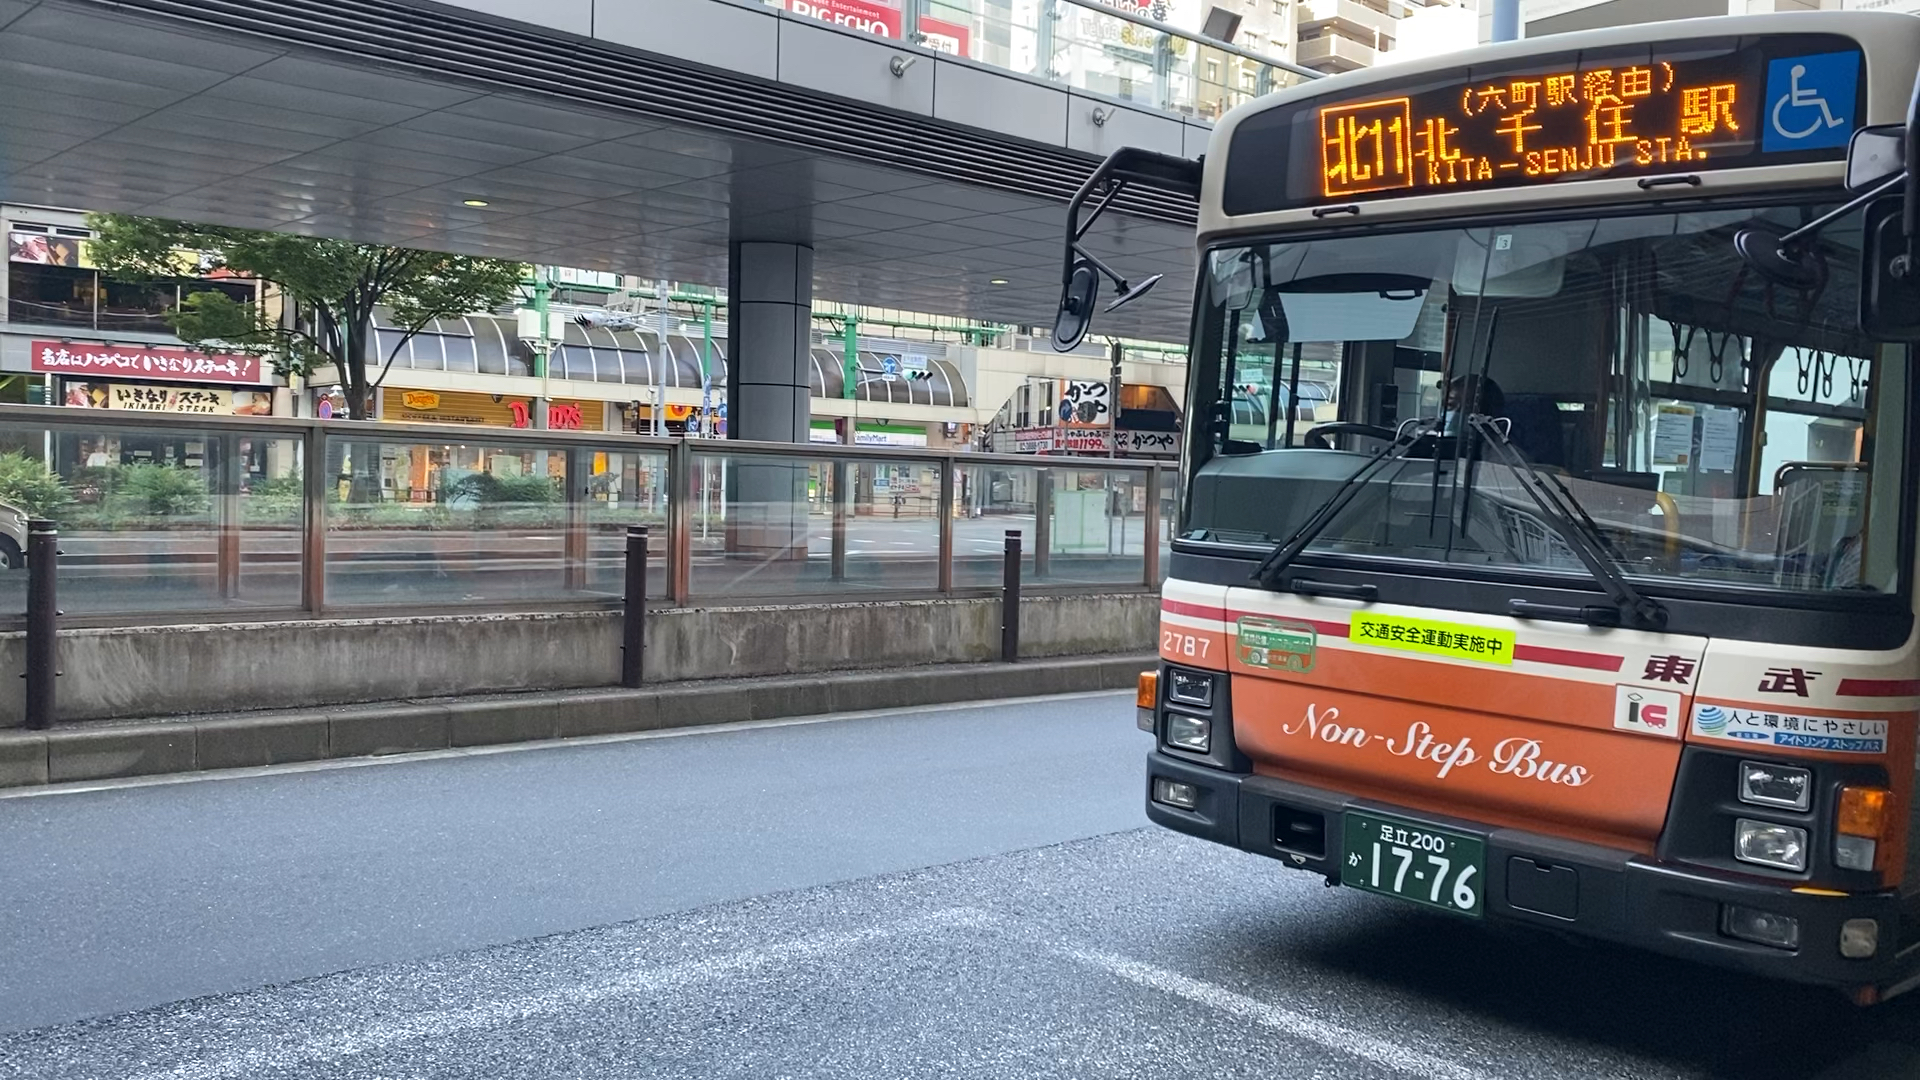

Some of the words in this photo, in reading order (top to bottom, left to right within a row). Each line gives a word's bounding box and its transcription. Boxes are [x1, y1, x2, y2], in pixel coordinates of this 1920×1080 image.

[834, 12, 889, 38] ECHO
[1327, 116, 1403, 184] 北11
[1428, 143, 1614, 184] KITA-SENJU
[1636, 136, 1707, 164] STA.
[116, 388, 168, 404] いきなり
[178, 391, 221, 406] ステーキ
[123, 402, 167, 411] IKINARI
[177, 404, 215, 413] STEAK
[1132, 432, 1174, 451] かつや
[1164, 631, 1210, 659] 2787
[1360, 621, 1502, 655] 交通安全運動実施中
[1641, 655, 1822, 698] 東武
[1728, 711, 1886, 737] 人と環境にやさしい
[1282, 703, 1482, 779] Non-Step
[1488, 737, 1594, 787] Bus
[1380, 825, 1445, 853] 足立200
[1348, 851, 1362, 867] か
[1371, 842, 1477, 910] 17-76
